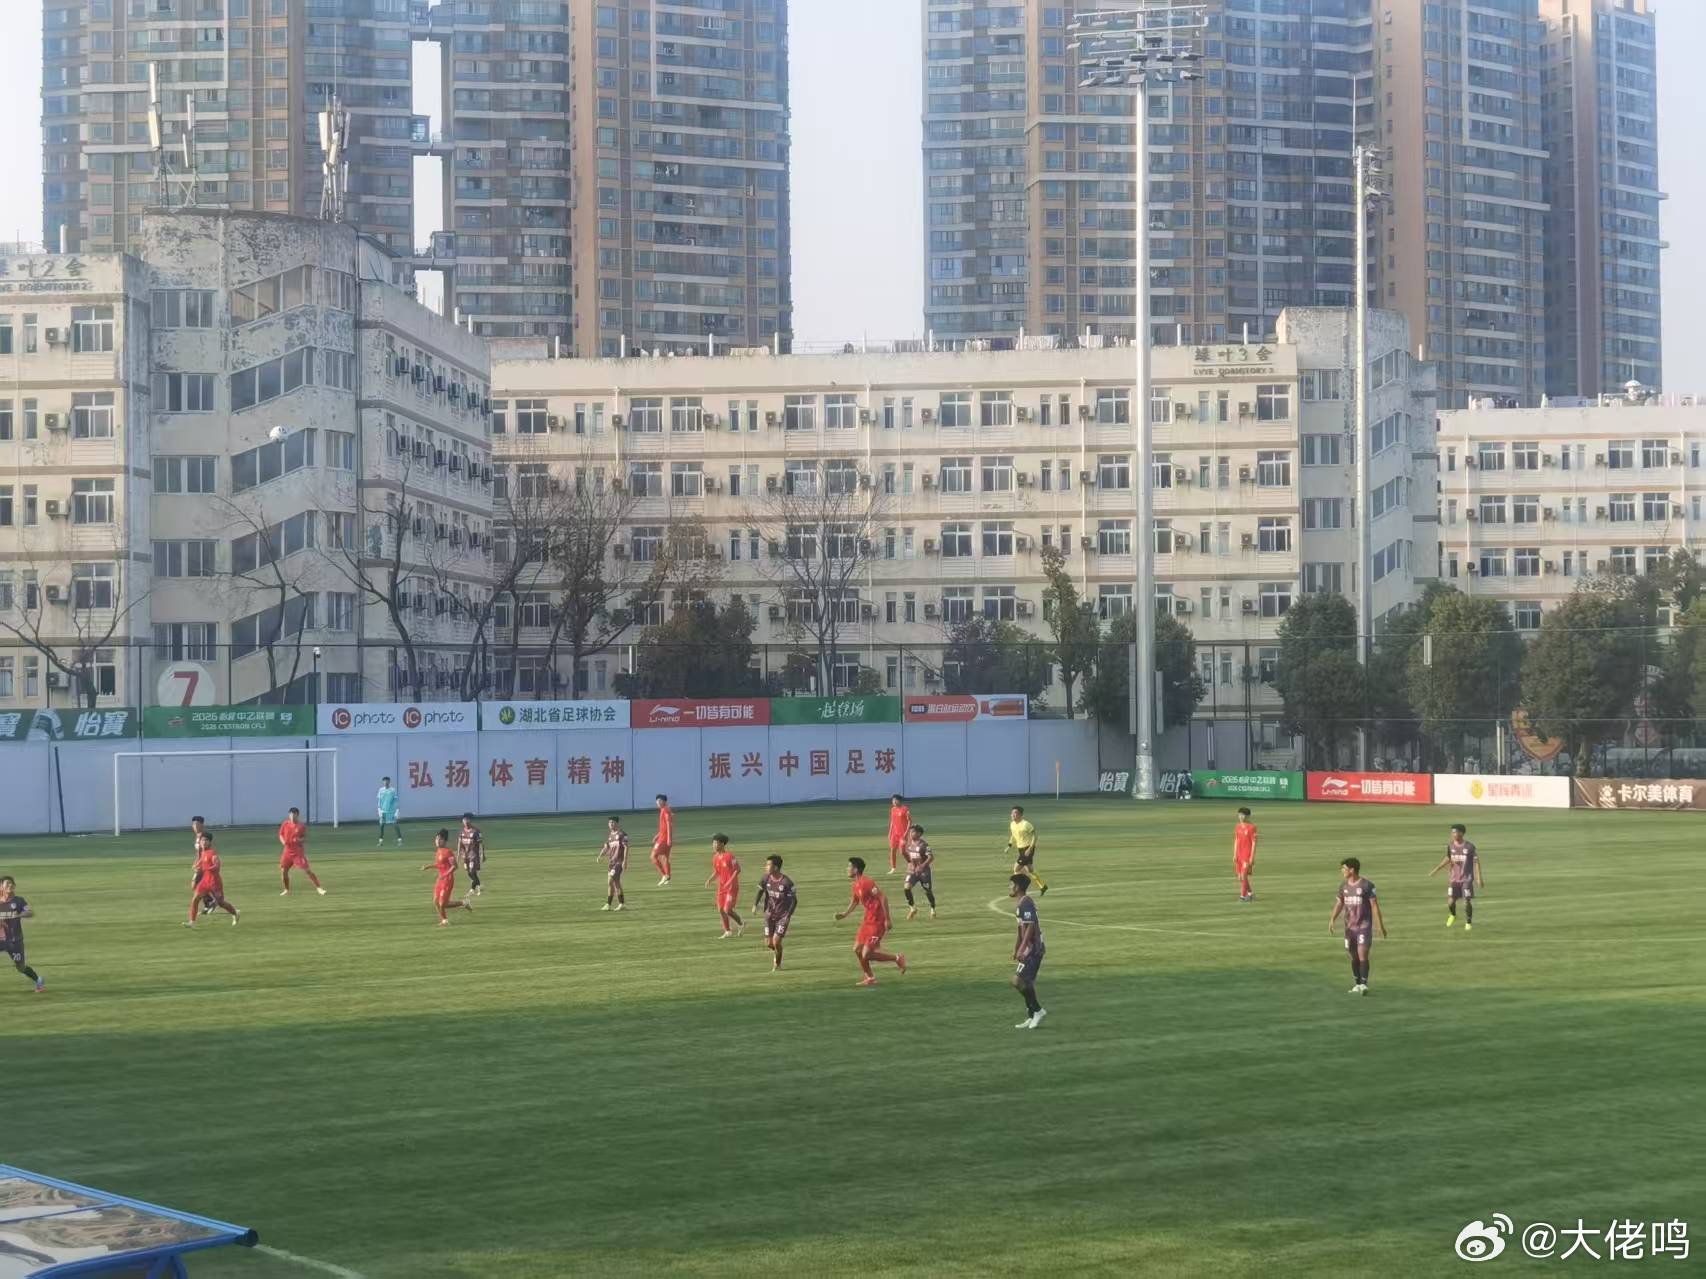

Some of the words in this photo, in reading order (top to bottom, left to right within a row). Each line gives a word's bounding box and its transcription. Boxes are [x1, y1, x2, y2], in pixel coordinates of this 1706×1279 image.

[173, 670, 199, 707] 7
[354, 710, 395, 727] photo
[424, 709, 465, 726] photo
[519, 706, 617, 723] 湖北省足球协会
[683, 704, 755, 720] 一切皆有可能
[74, 711, 129, 736] 怡寶
[408, 755, 625, 788] 弘扬体育精神
[708, 748, 896, 779] 振兴中国足球
[1100, 772, 1128, 792] 怡寶
[1350, 779, 1416, 796] 一切皆有可能
[1617, 784, 1693, 803] 卡尔美体育
